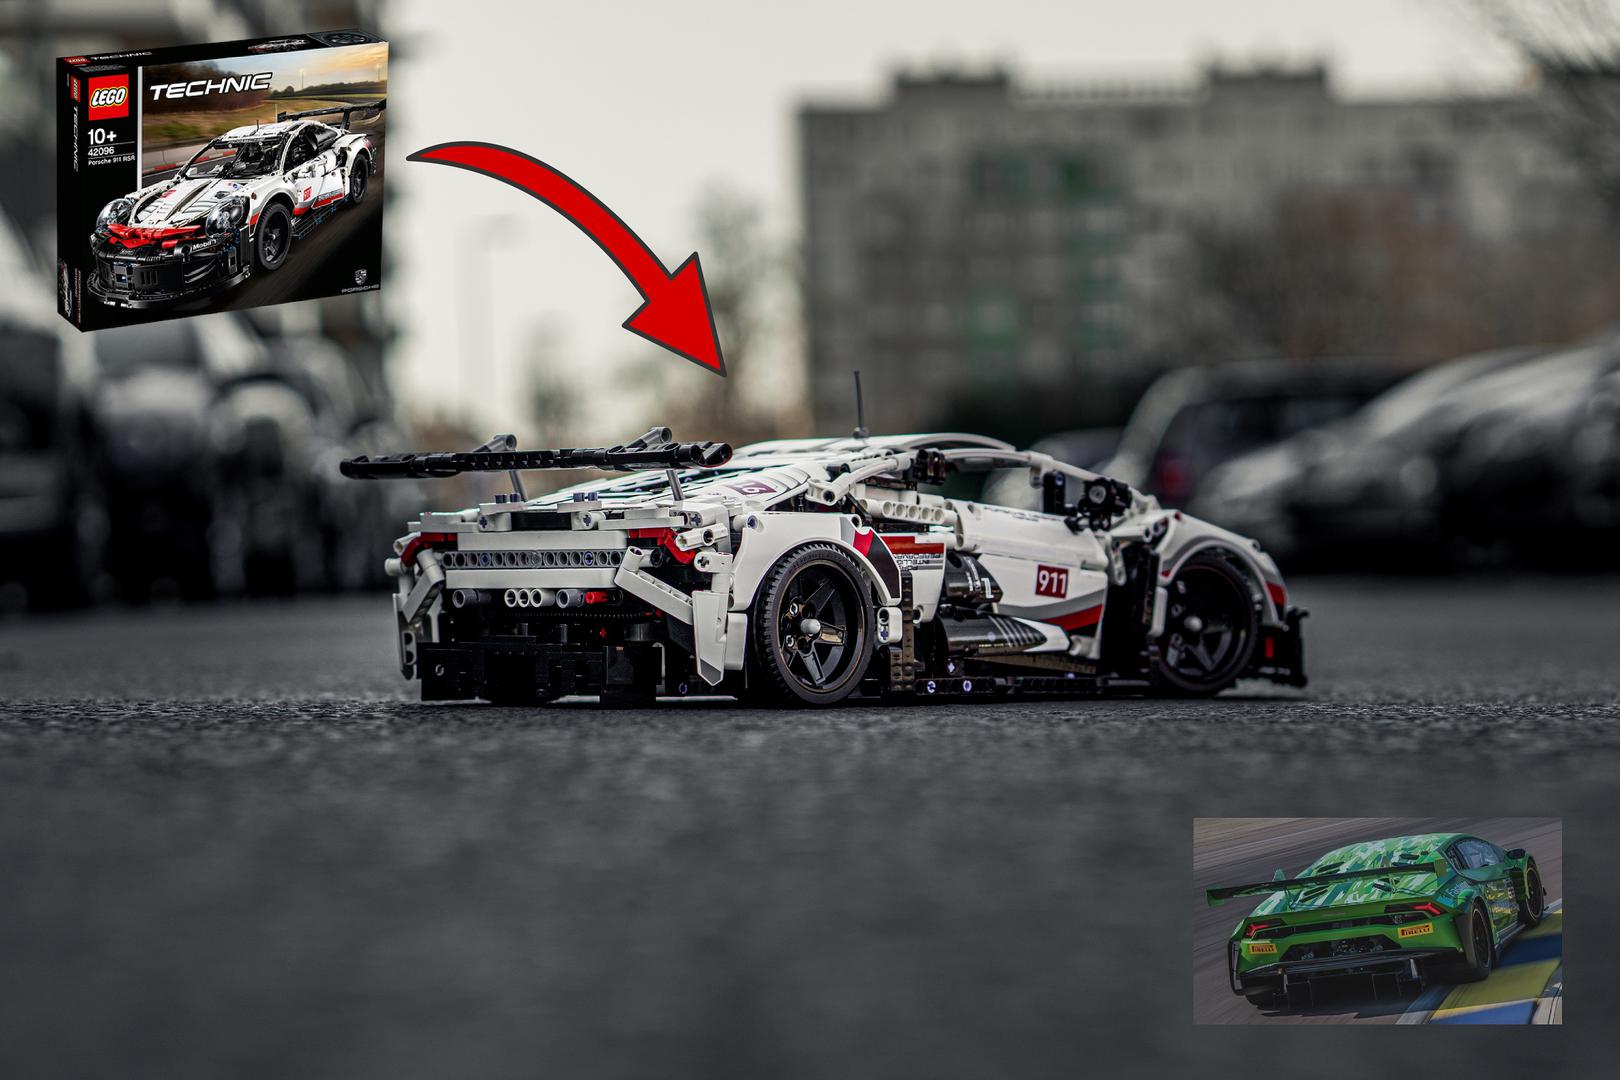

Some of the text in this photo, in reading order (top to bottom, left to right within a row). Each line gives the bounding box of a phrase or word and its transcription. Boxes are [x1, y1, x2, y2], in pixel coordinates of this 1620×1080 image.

[150, 72, 272, 101] TECHNIC
[90, 87, 127, 108] LEGO
[88, 128, 117, 145] 10+
[88, 147, 115, 157] 42096
[88, 157, 111, 166] Porsche
[1039, 570, 1067, 594] 911
